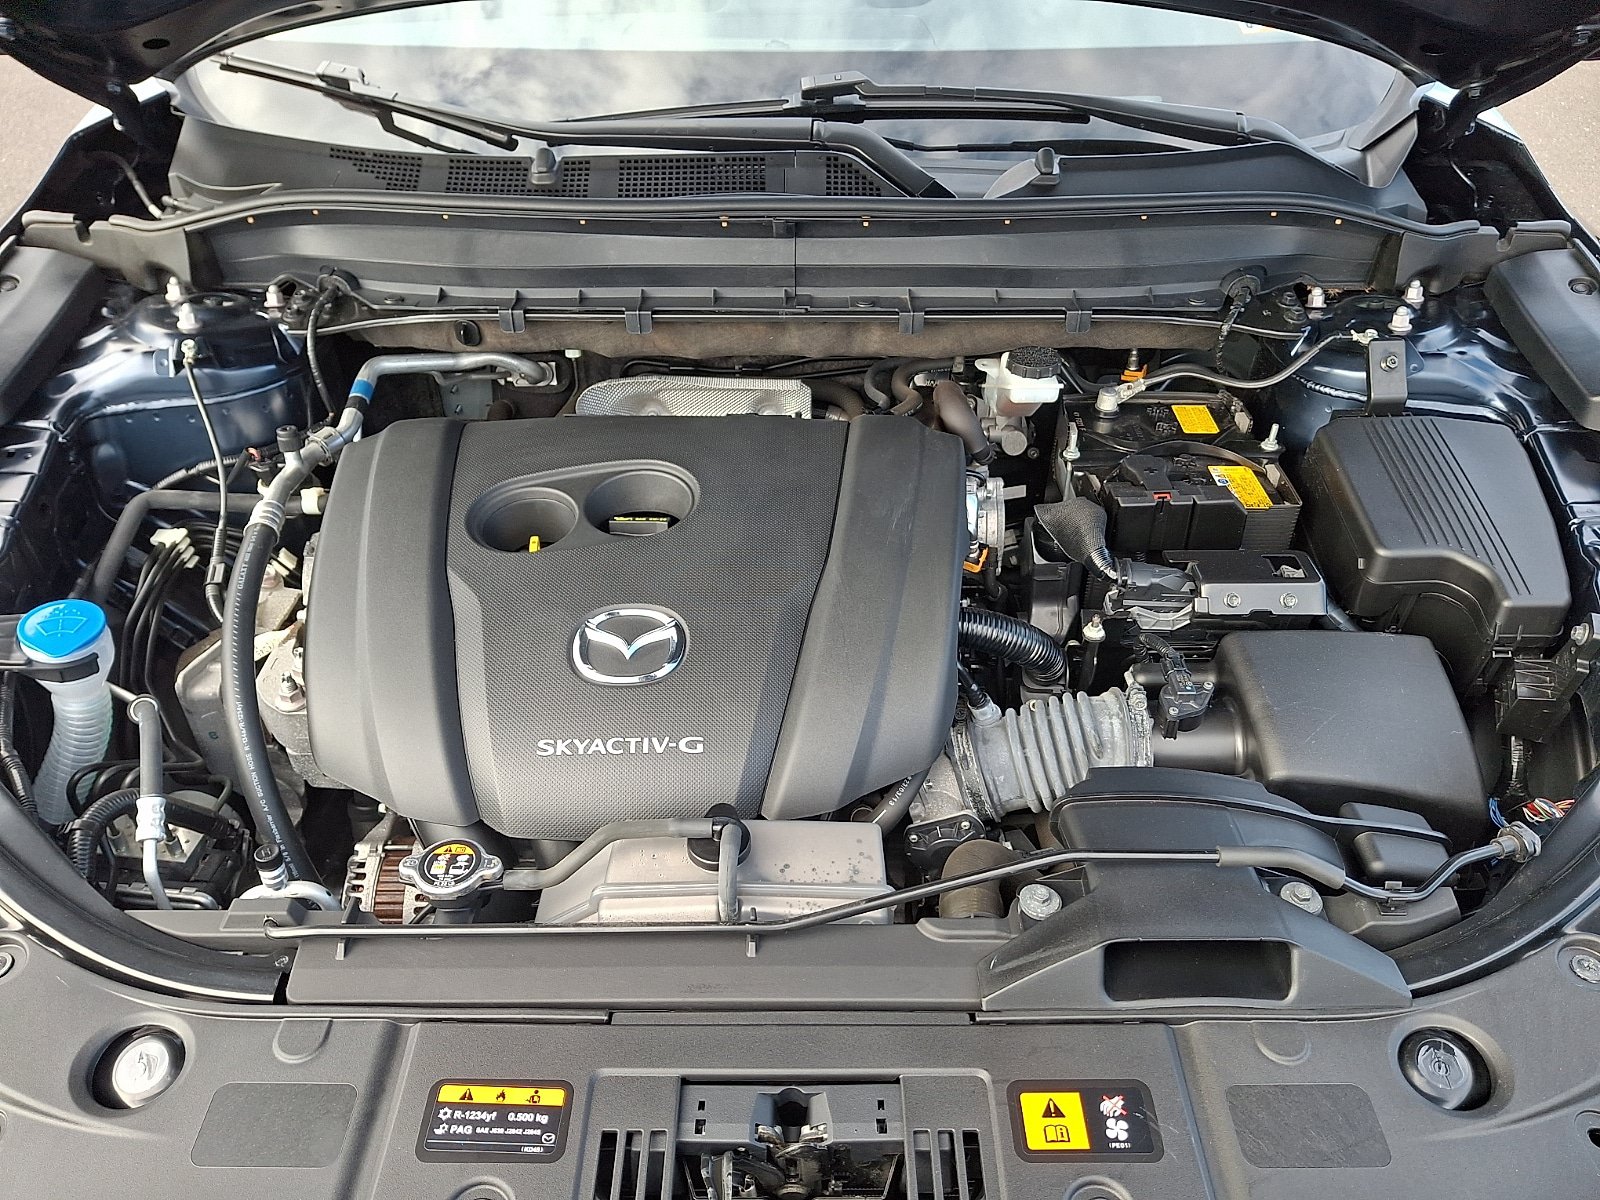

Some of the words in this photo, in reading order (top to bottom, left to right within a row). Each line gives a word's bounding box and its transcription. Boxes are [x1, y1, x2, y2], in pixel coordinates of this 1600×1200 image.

[237, 563, 248, 590] GALAXY
[536, 736, 704, 757] SKYACTIV-G
[246, 753, 255, 770] HOSE
[251, 772, 264, 797] SUCTION
[260, 799, 269, 812] A/C
[453, 1110, 497, 1123] R-1234yf
[507, 1112, 535, 1122] 0.500
[535, 1113, 549, 1124] kg
[449, 1125, 473, 1134] PAG
